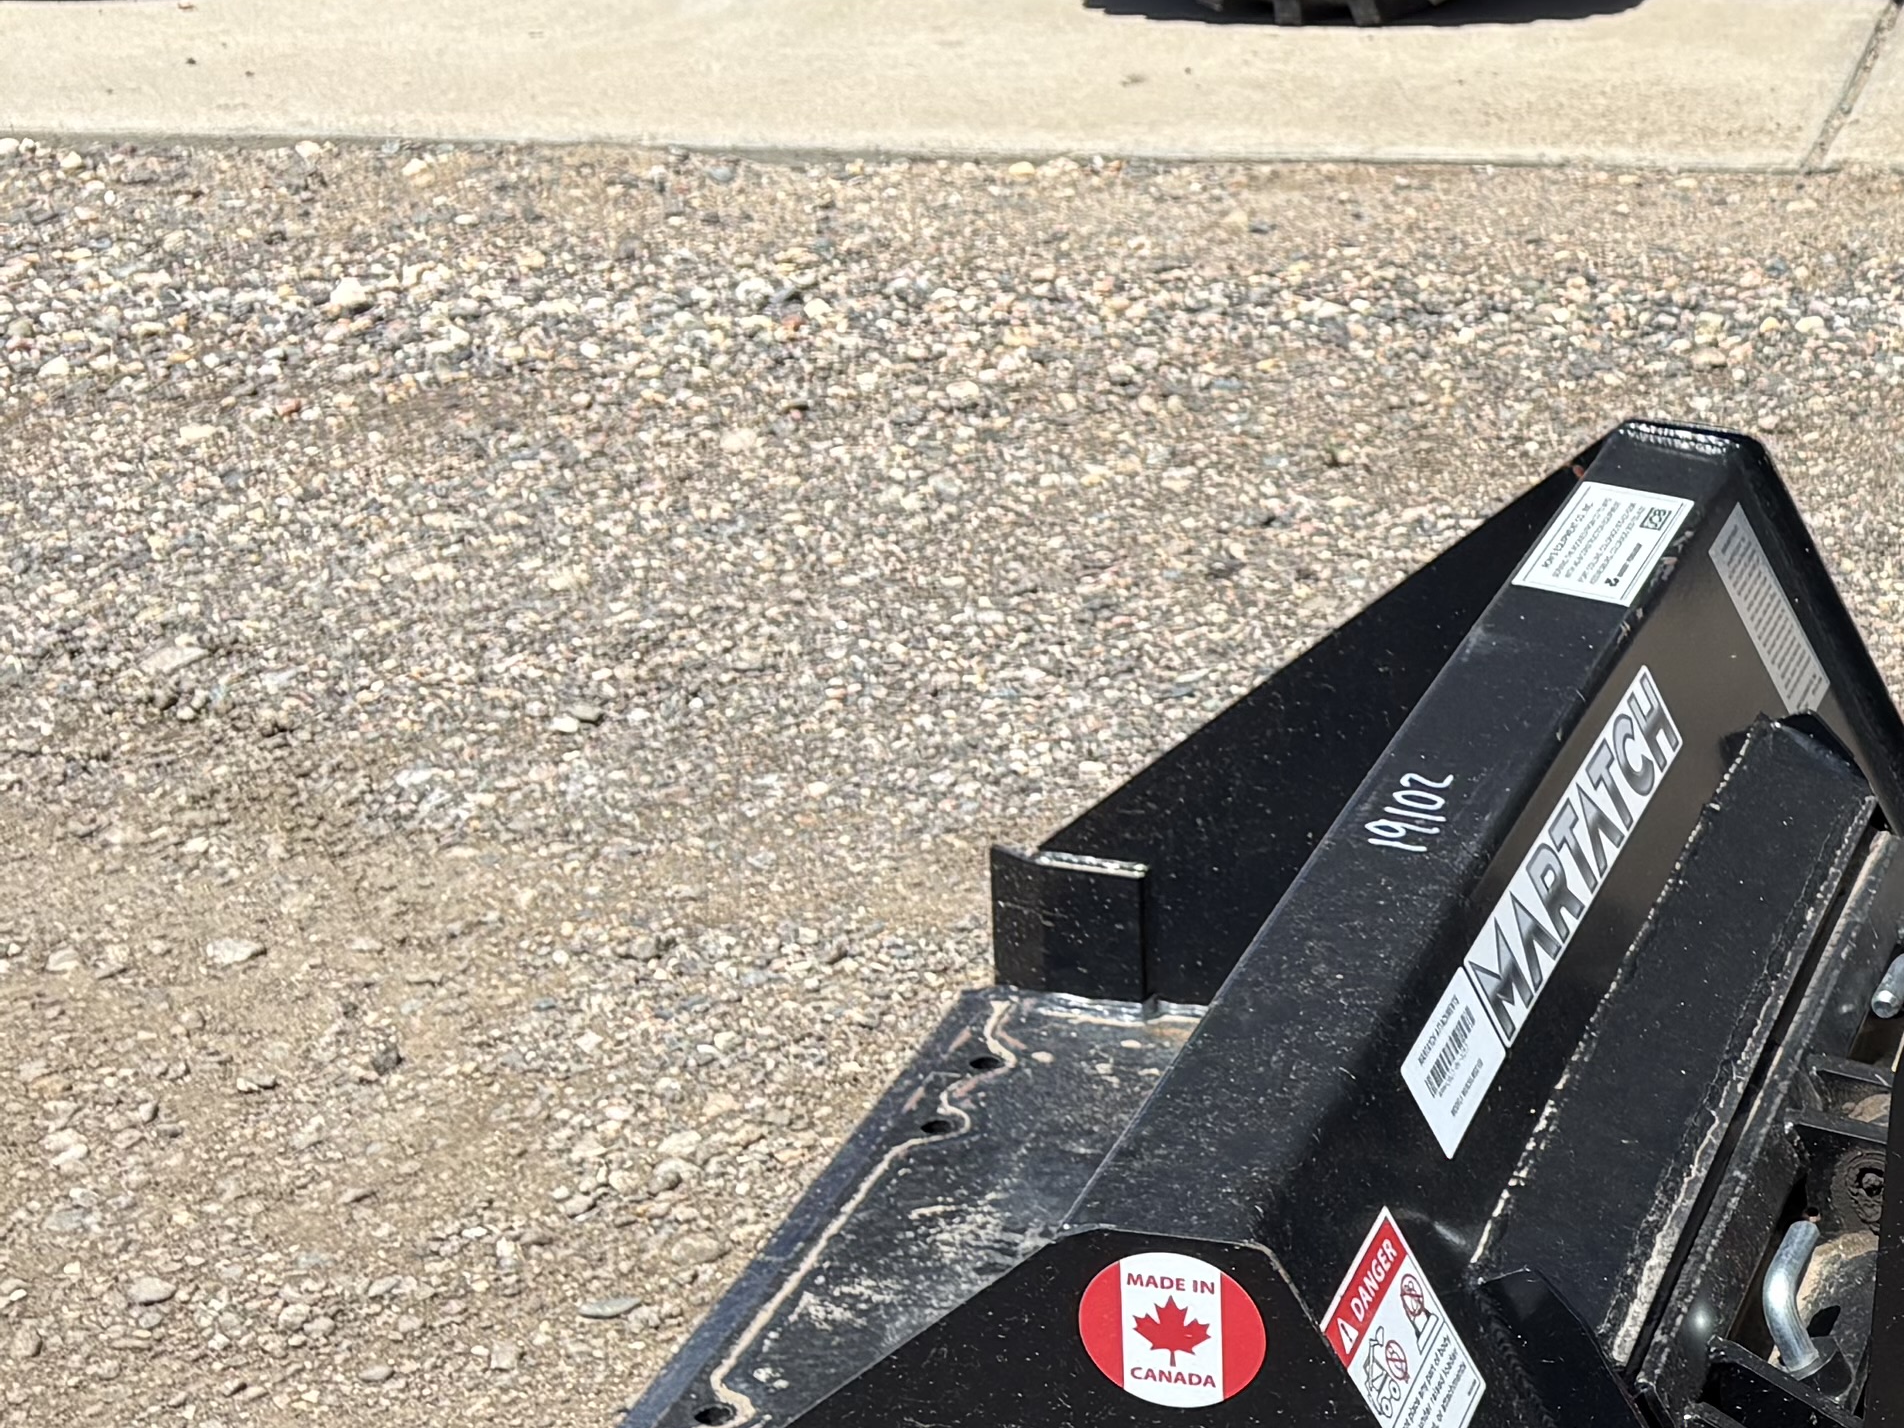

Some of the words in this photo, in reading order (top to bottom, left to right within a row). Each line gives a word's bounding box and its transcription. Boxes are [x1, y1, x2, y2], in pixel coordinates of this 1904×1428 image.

[1364, 772, 1454, 852] 19102
[1467, 670, 1680, 1043] MARTATCH
[1126, 1272, 1186, 1292] MADE
[1192, 1279, 1215, 1295] IN
[1350, 1238, 1397, 1323] DANGER
[1130, 1366, 1217, 1389] CANADA
